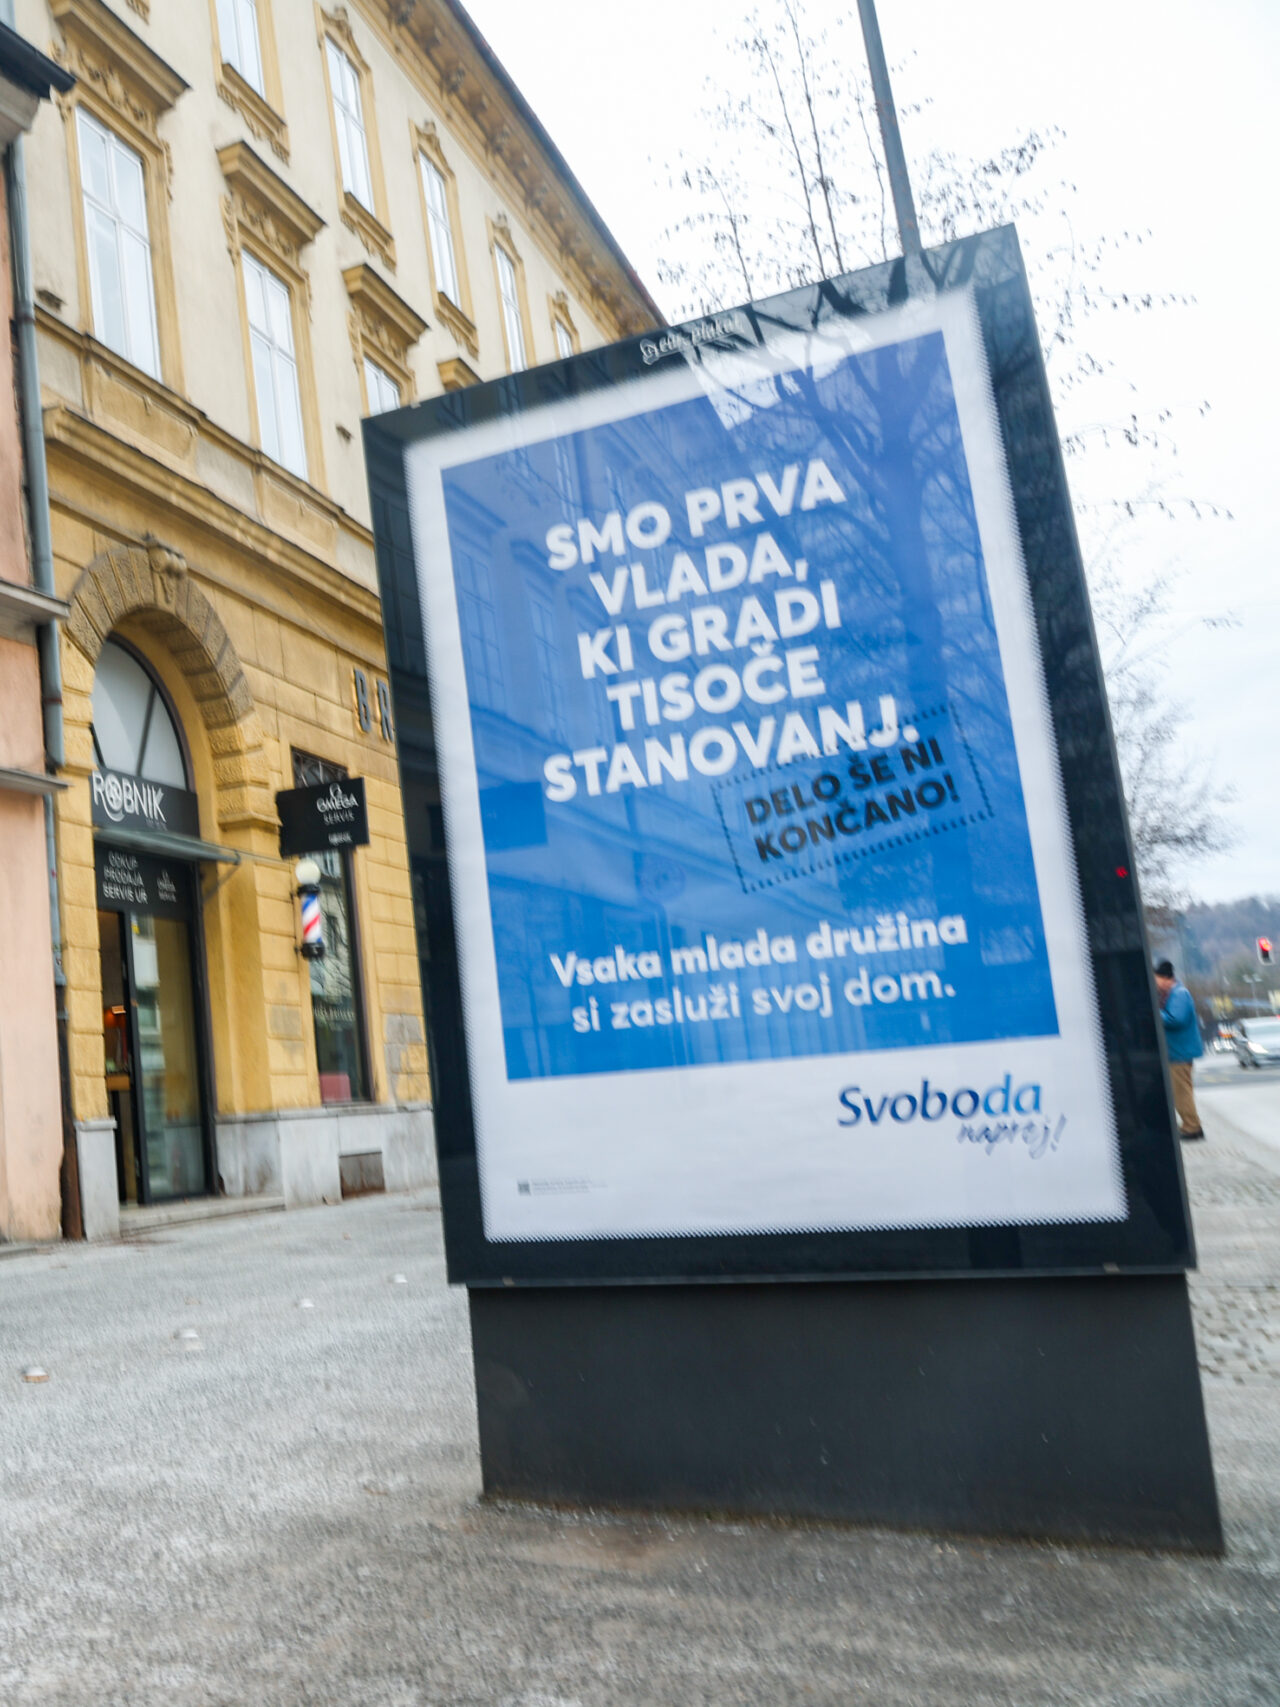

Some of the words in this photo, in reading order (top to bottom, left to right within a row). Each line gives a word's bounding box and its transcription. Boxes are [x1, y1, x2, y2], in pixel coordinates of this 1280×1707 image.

[544, 501, 672, 571] SMO
[684, 458, 847, 538] PRVA
[588, 531, 808, 616] VLADA,
[577, 625, 634, 680] KI
[647, 580, 843, 663] GRADI
[606, 643, 826, 731] TISOČE
[543, 694, 920, 803] STANOVANJ.
[745, 773, 841, 825] DELO
[847, 752, 896, 791] ŠE
[898, 737, 945, 775] NI
[91, 770, 167, 823] ROBNIK
[316, 793, 359, 812] OMEGA
[754, 772, 961, 864] KONČANO!
[102, 881, 135, 903] SERVIS
[103, 865, 144, 888] PRODAJA
[549, 945, 663, 988] Vsaka
[670, 928, 798, 976] mlada
[806, 911, 969, 959] družina
[572, 996, 601, 1034] si
[610, 982, 741, 1030] zasluži
[751, 974, 833, 1019] svoj
[844, 966, 957, 1007] dom.
[837, 1070, 1042, 1127] Svoboda
[956, 1112, 1067, 1160] naprej!
